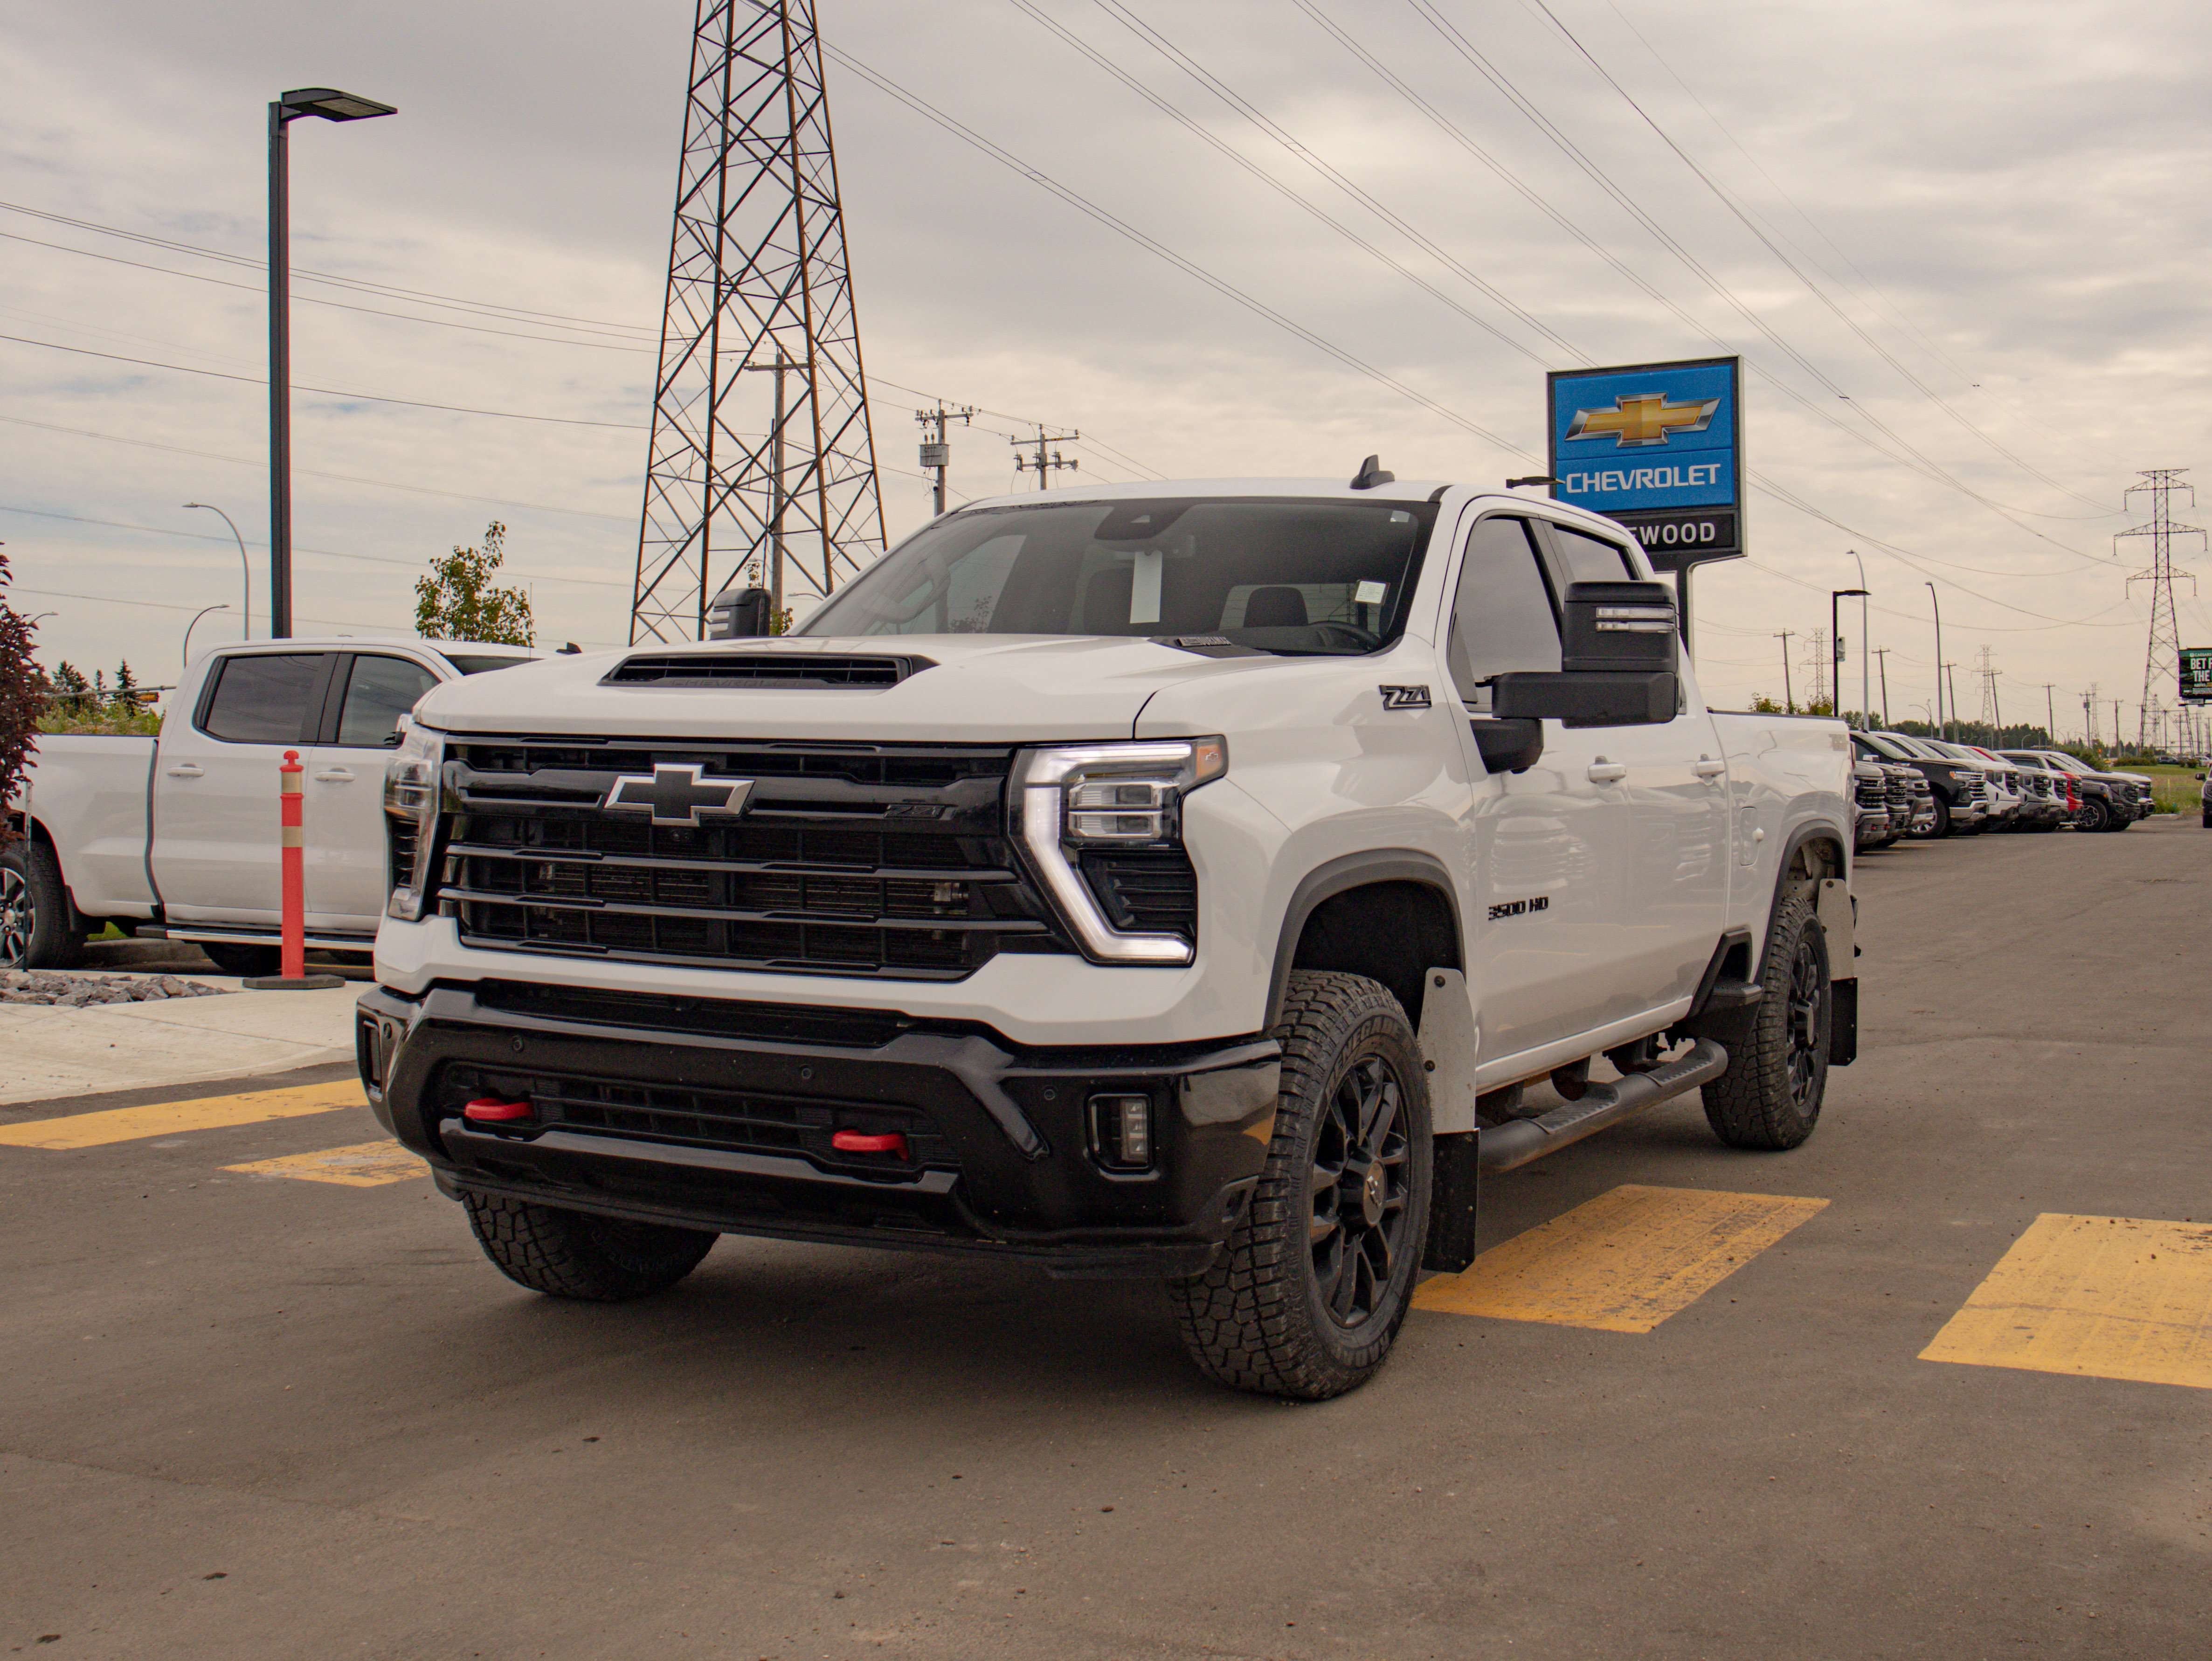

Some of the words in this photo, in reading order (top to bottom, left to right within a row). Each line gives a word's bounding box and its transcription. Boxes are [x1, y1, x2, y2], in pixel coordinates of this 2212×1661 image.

[1566, 464, 1721, 493] CHEVROLET
[2190, 658, 2207, 670] BET
[2193, 670, 2210, 682] THE
[1379, 685, 1432, 710] Z71
[1488, 900, 1526, 920] 3500
[1529, 896, 1548, 913] HD
